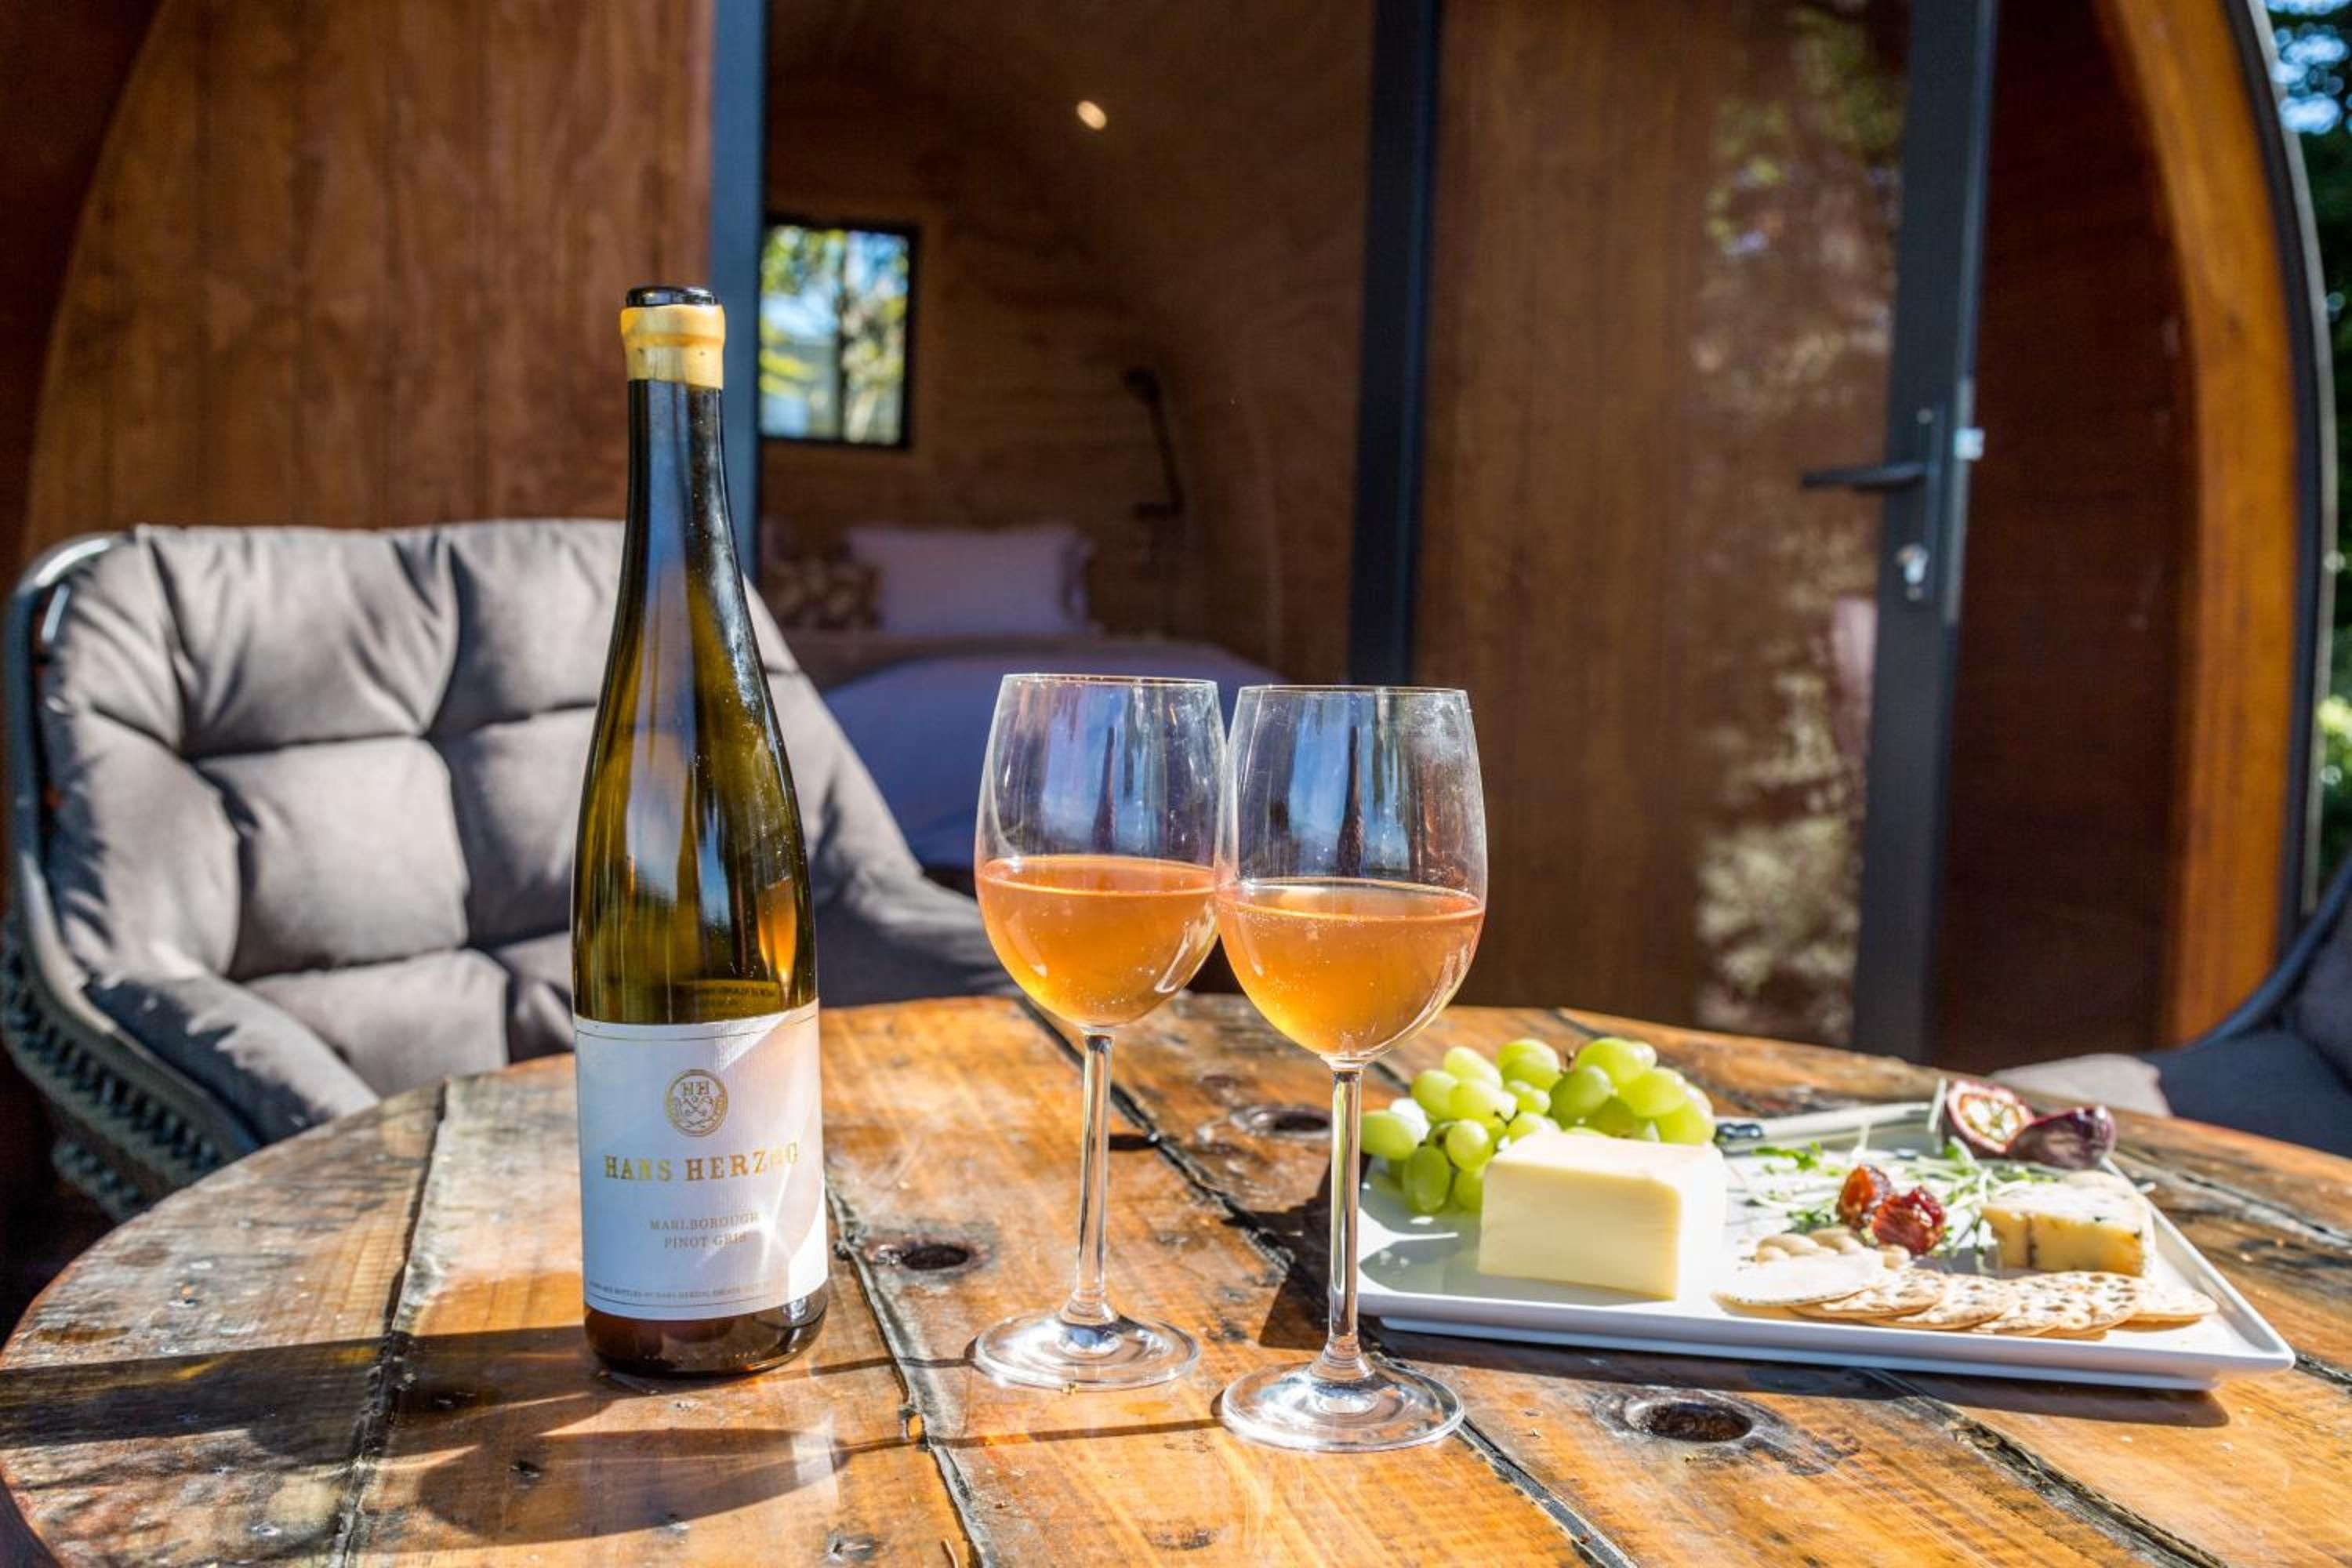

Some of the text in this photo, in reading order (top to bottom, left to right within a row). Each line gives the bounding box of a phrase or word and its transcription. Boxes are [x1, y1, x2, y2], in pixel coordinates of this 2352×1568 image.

[604, 1154, 672, 1181] HANS
[650, 1211, 759, 1230] MARLBOROUGH
[664, 1235, 709, 1249] PINOT
